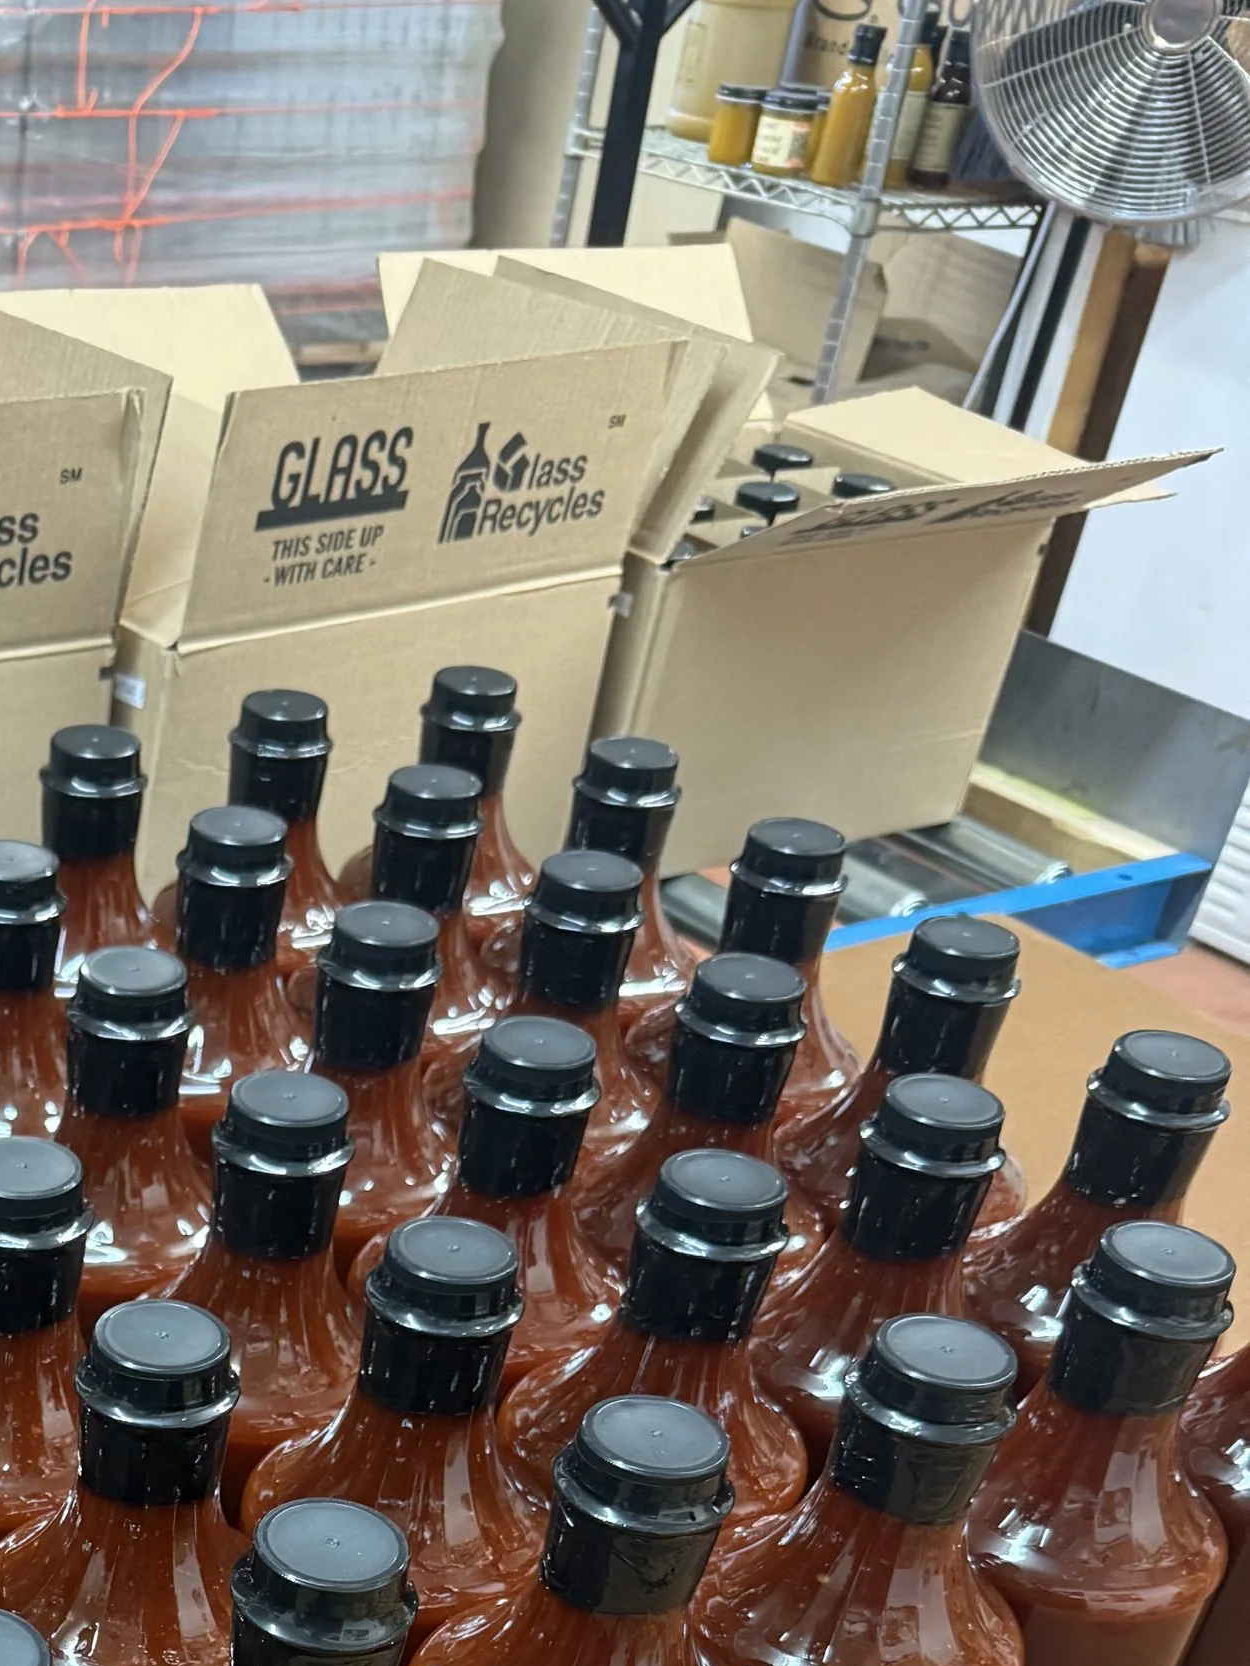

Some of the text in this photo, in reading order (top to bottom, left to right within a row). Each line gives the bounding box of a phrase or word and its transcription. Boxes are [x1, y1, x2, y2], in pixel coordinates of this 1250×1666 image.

[271, 426, 414, 511] GLASS
[477, 486, 605, 537] Recycles
[272, 525, 384, 561] THIS SIDE UP
